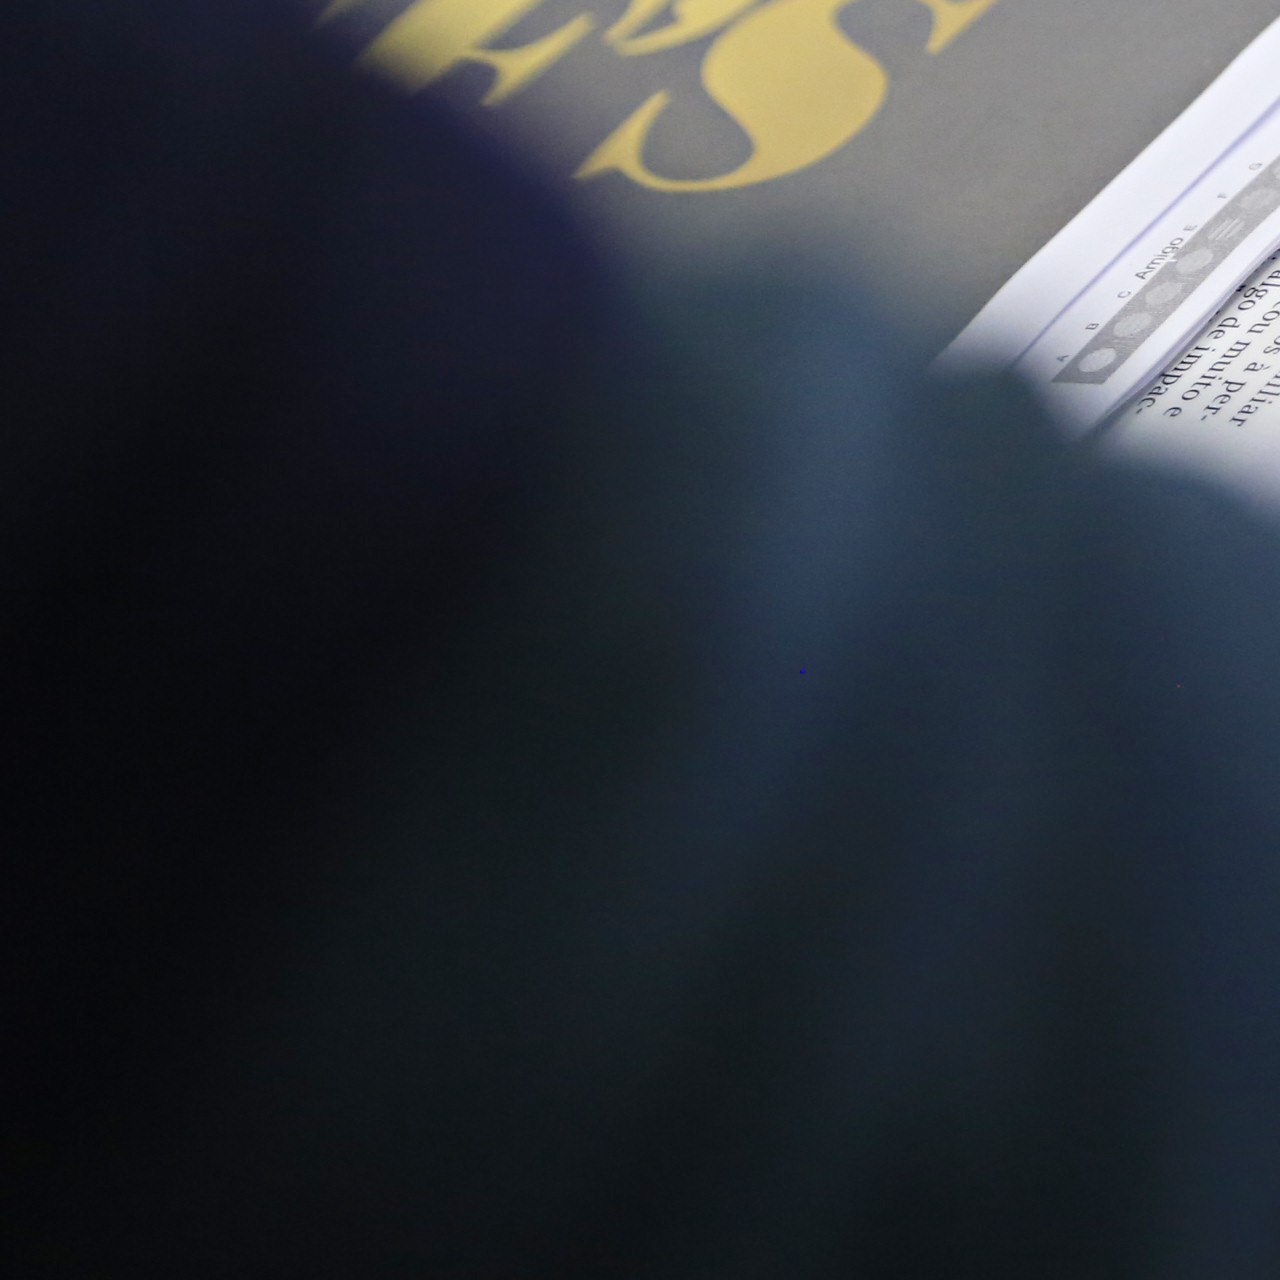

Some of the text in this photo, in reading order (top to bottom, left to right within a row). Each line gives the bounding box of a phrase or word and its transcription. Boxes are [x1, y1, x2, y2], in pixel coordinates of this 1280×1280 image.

[1135, 236, 1184, 280] Amigo
[1206, 316, 1241, 340] de
[1136, 345, 1217, 414] impac-
[1181, 340, 1252, 401] muito
[1242, 361, 1271, 372] à
[1163, 406, 1183, 418] e
[1200, 379, 1247, 421] per-
